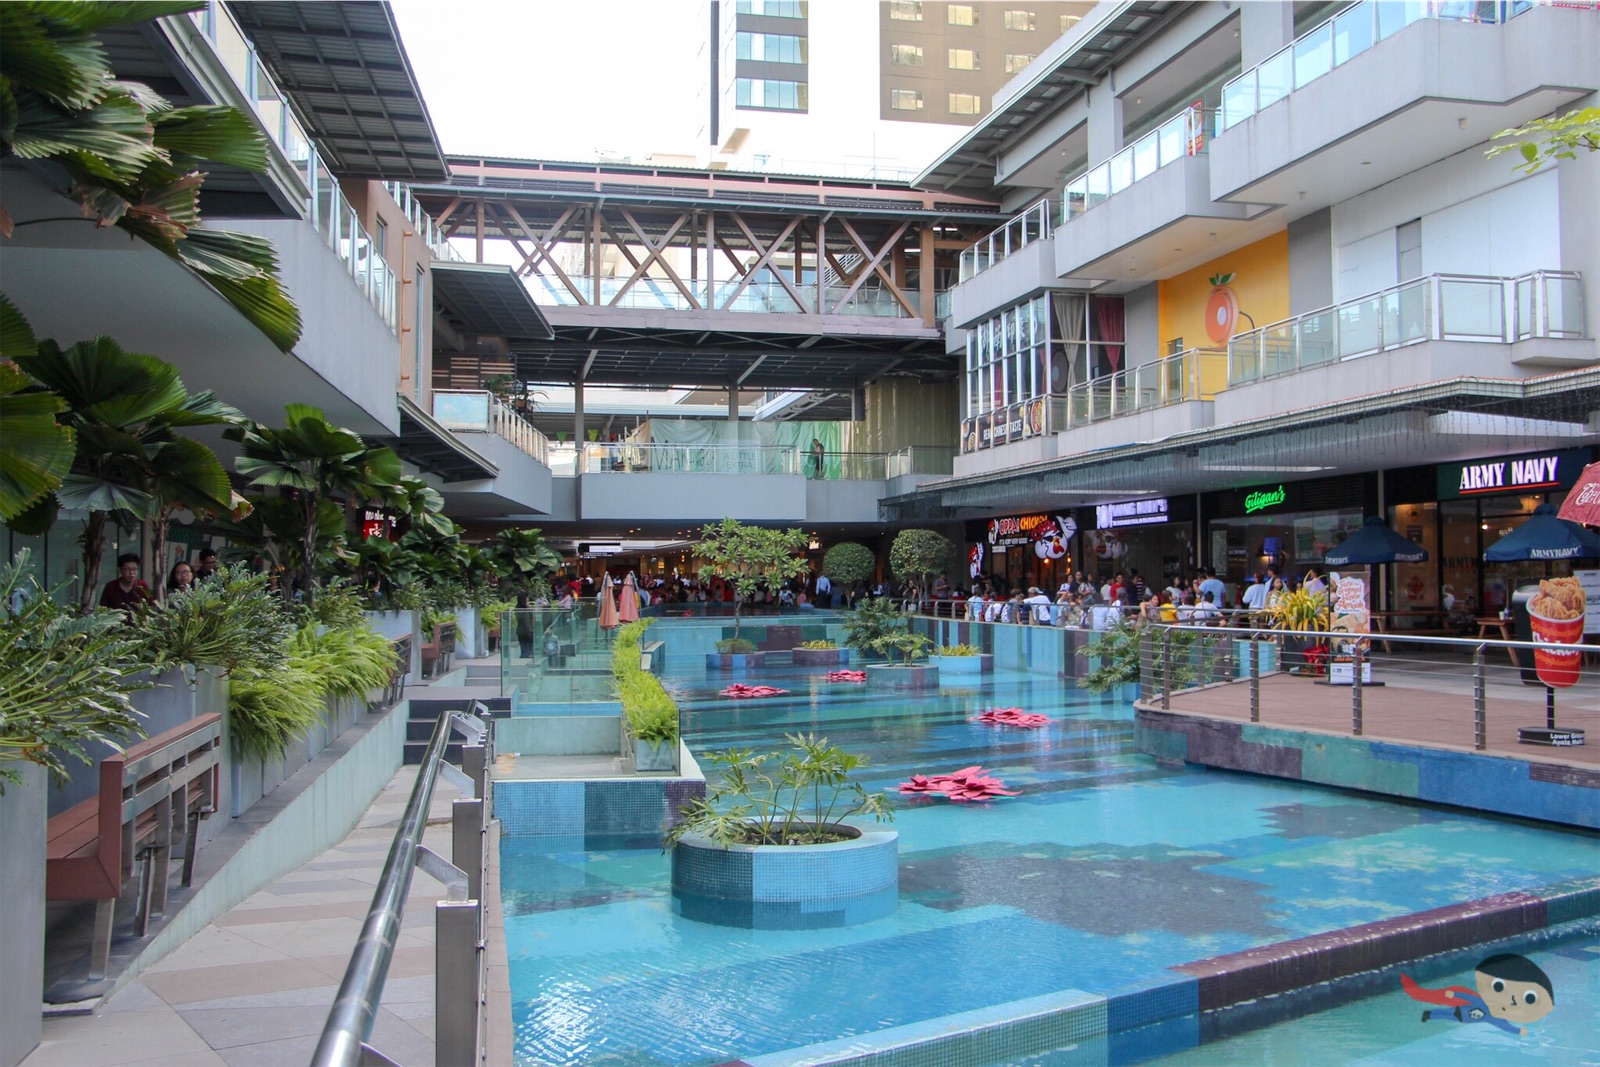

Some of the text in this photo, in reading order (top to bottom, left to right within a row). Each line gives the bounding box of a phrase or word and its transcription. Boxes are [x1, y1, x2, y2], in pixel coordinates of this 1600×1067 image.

[983, 419, 1022, 440] REA CHINES TASTE
[732, 452, 756, 461] LTTLE
[726, 461, 753, 470] EXTRA
[1459, 456, 1559, 490] ARMY NAVY
[1244, 485, 1286, 510] Giligan's
[1551, 739, 1571, 747] Ayala
